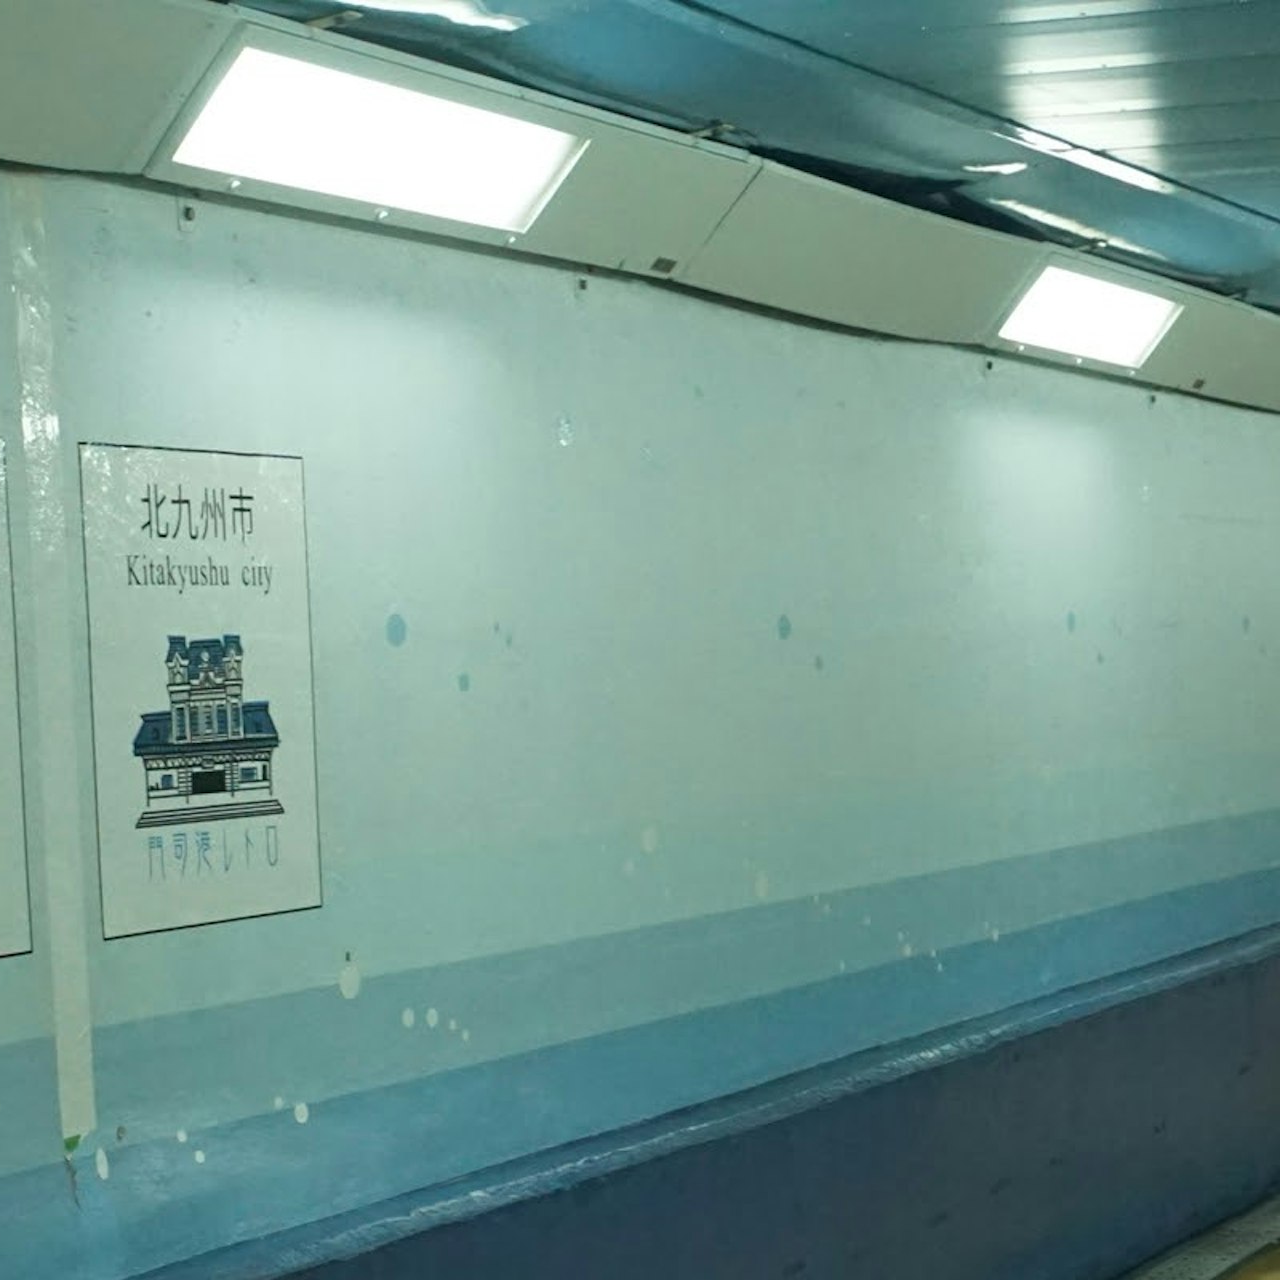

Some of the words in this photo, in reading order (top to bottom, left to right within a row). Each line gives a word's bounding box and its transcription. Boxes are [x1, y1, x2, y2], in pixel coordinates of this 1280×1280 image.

[140, 483, 255, 545] 北九州市
[125, 554, 231, 595] Kitakyushu
[240, 555, 273, 596] city
